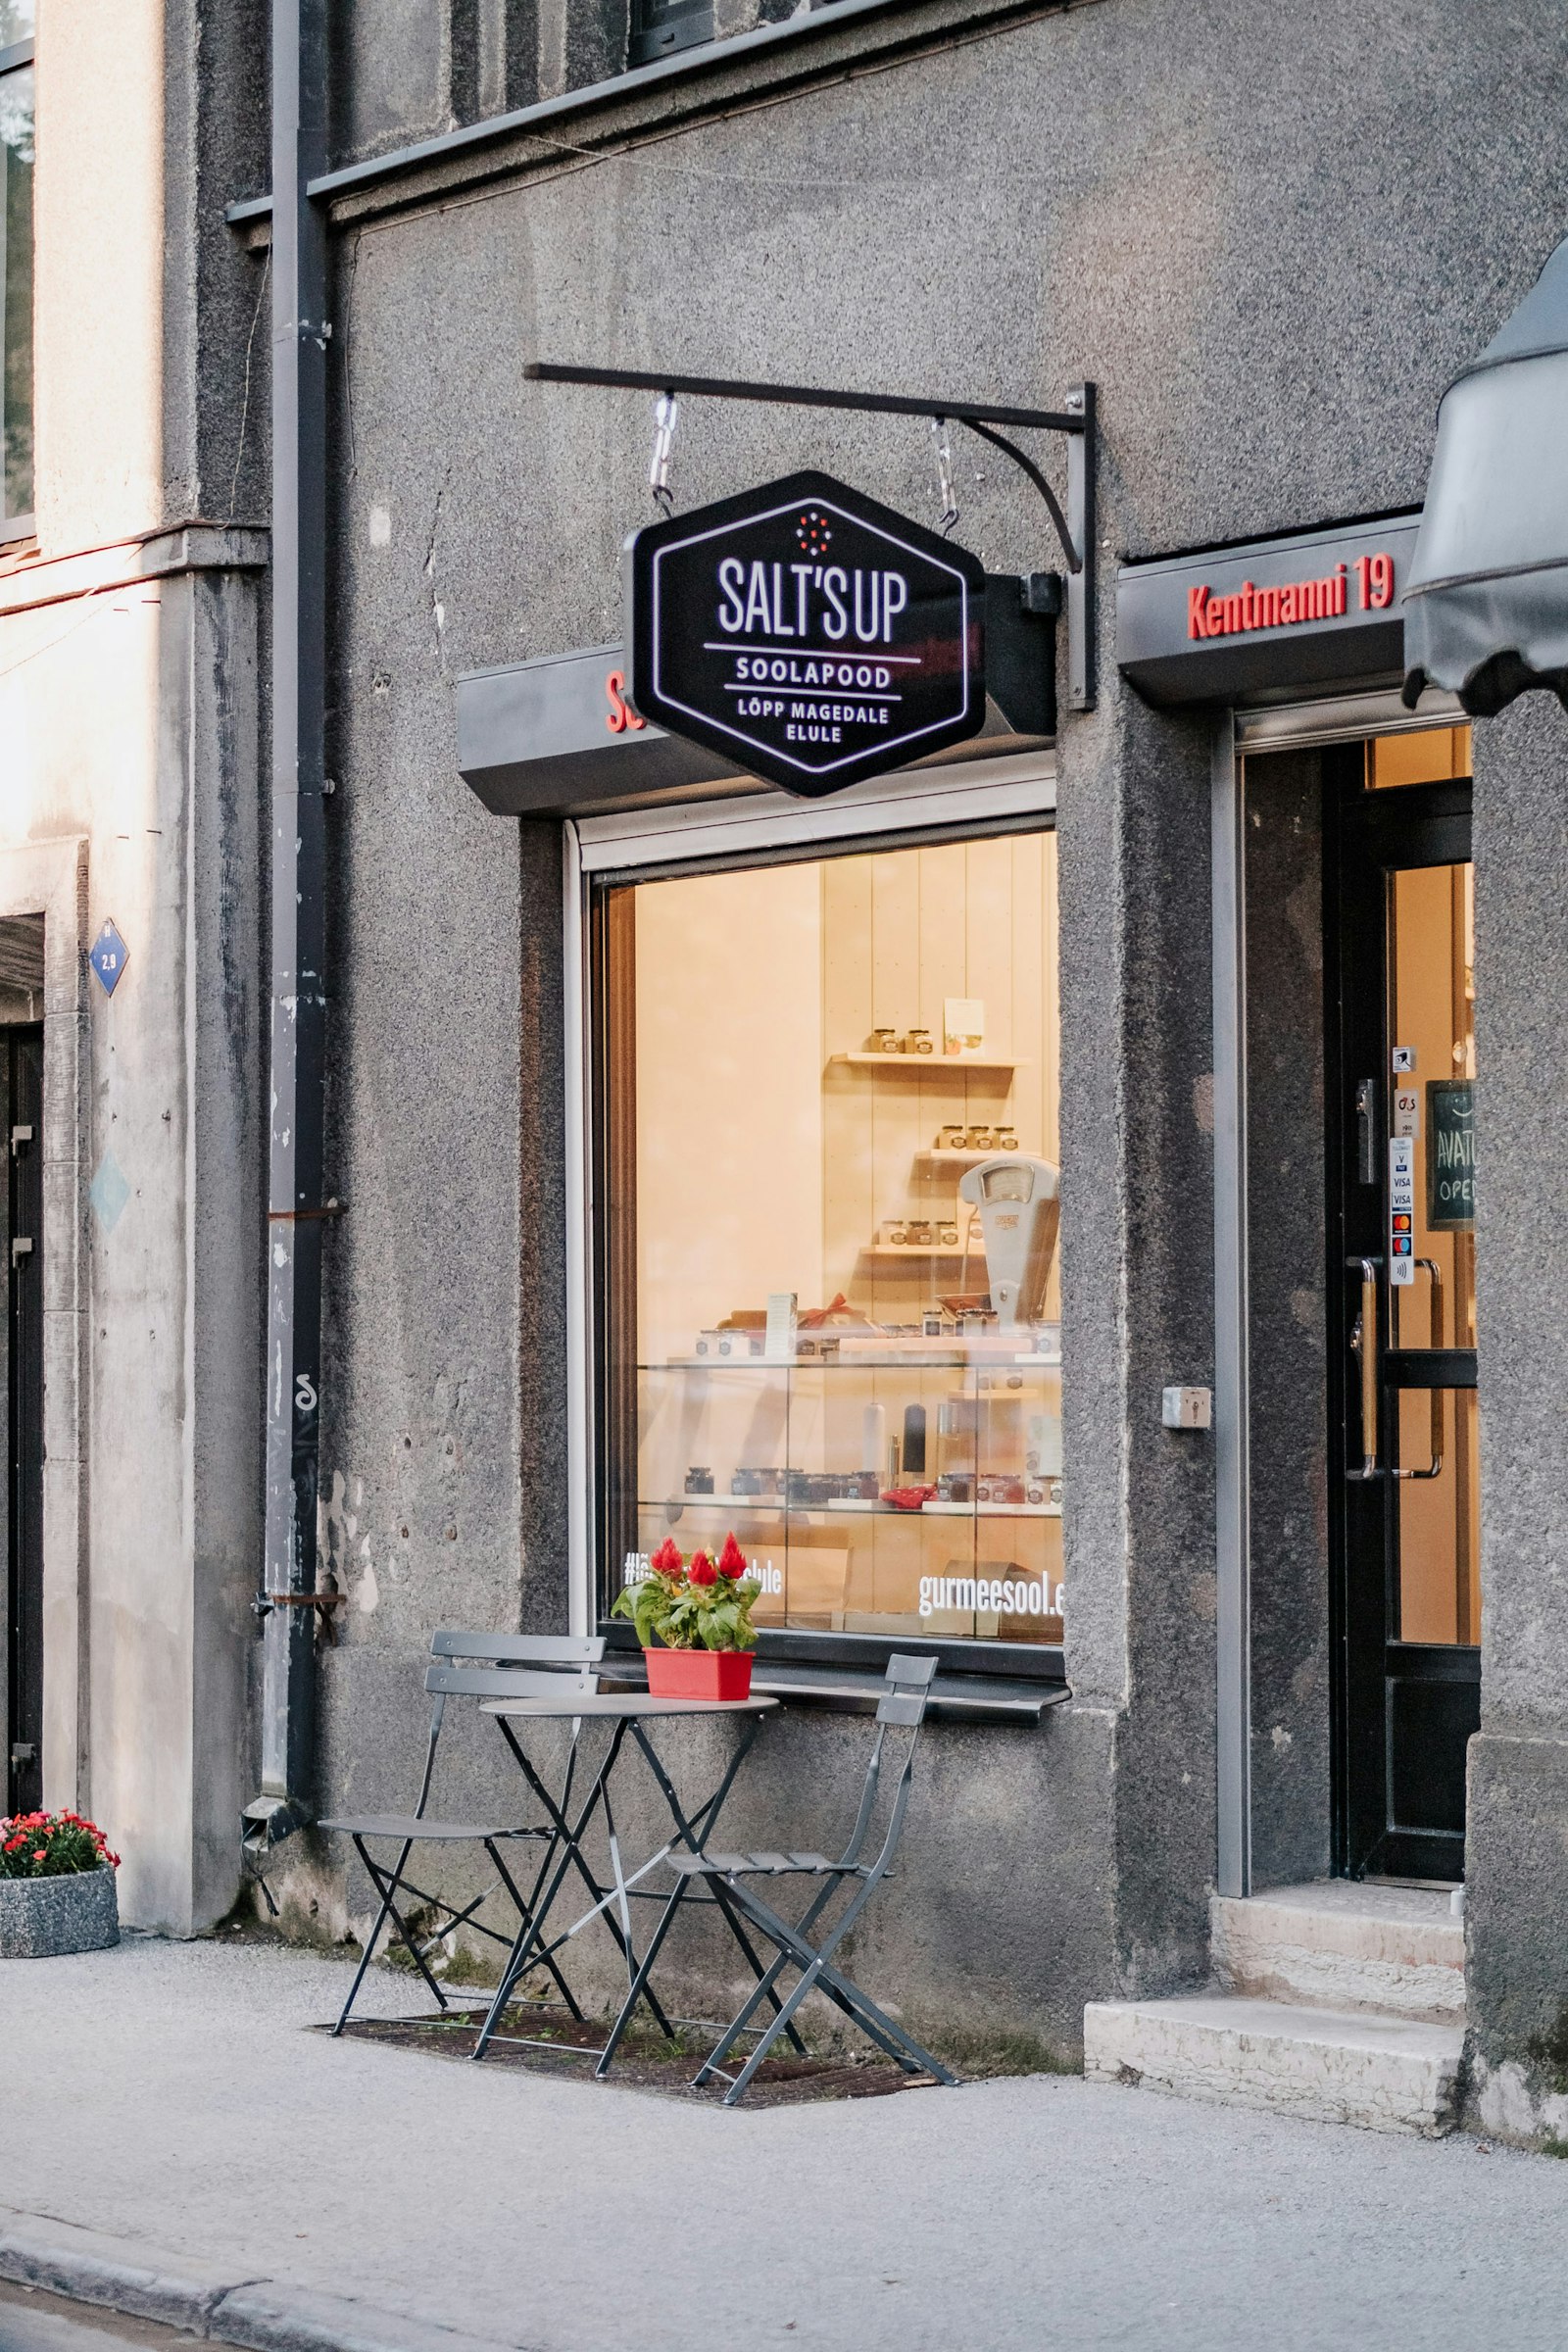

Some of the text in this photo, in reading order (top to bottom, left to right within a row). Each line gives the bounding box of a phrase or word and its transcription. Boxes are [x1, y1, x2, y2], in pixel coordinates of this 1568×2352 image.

[1188, 553, 1395, 640] Kentmanni 19
[736, 657, 891, 689] SOOLAPOOD
[738, 697, 889, 724] LÕPP MAGEDALE
[786, 723, 842, 743] ELULE
[1394, 1178, 1411, 1187] VISA
[1394, 1196, 1411, 1204] VISA
